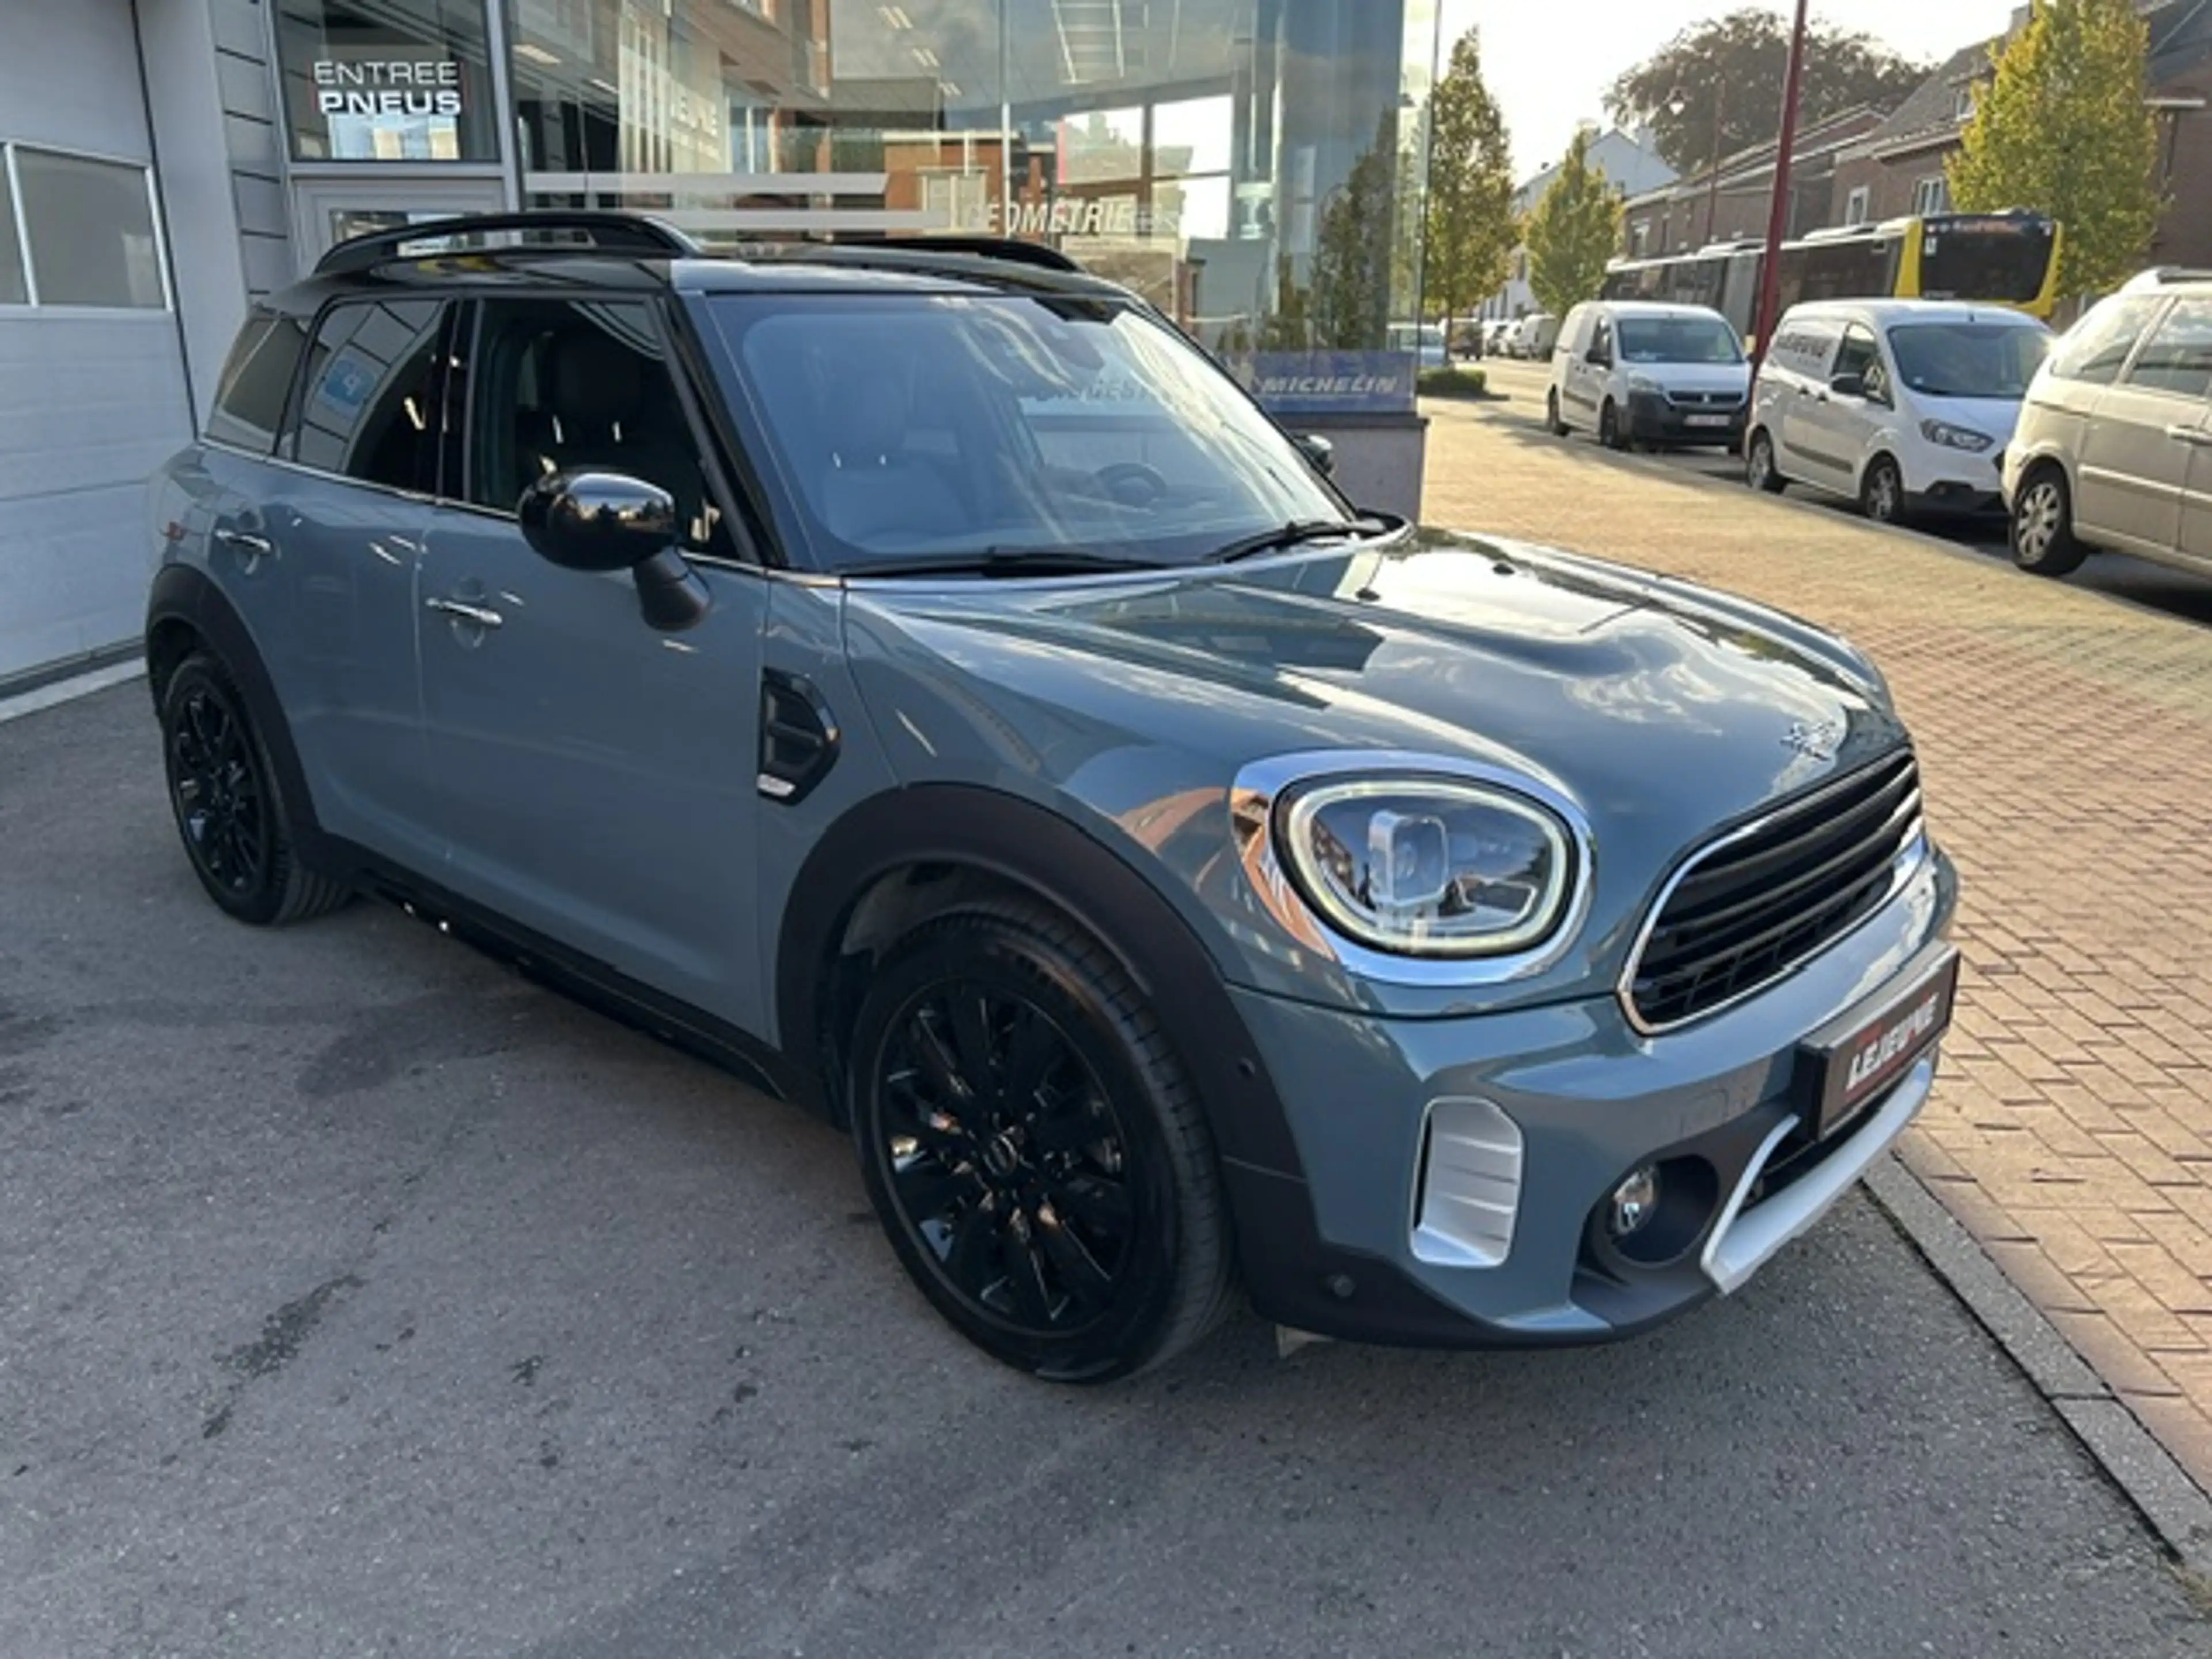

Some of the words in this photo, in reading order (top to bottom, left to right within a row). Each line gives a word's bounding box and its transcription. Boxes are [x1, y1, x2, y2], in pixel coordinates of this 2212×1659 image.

[314, 61, 458, 84] ENTREE
[318, 90, 461, 115] PNEUS
[1262, 374, 1397, 393] MICHELIN
